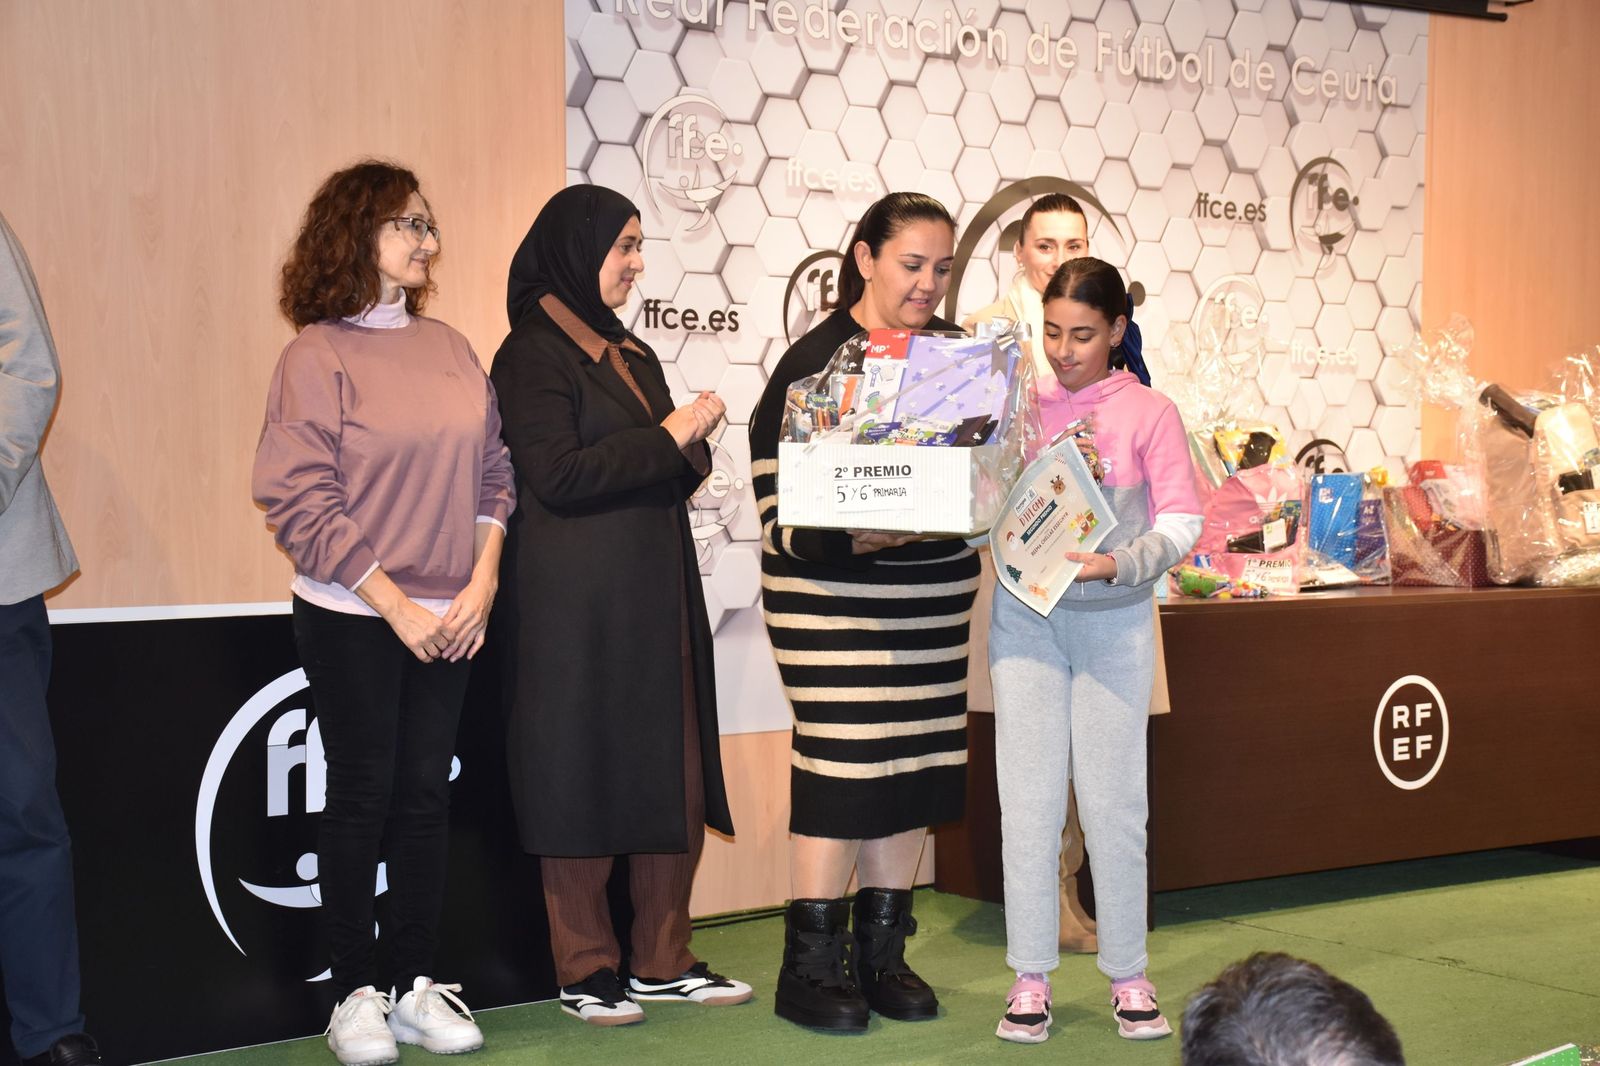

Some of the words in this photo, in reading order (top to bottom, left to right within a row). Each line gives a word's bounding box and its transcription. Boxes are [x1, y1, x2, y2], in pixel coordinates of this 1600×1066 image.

[748, 0, 1008, 61] Federación
[1026, 23, 1079, 69] de
[1096, 28, 1214, 85] Fútbol
[1229, 52, 1276, 91] de
[1291, 56, 1398, 104] Ceuta
[1196, 192, 1267, 223] ffce.es
[643, 298, 740, 333] ffce.es
[853, 464, 912, 478] PREMIO
[873, 486, 907, 498] PRIMARIA
